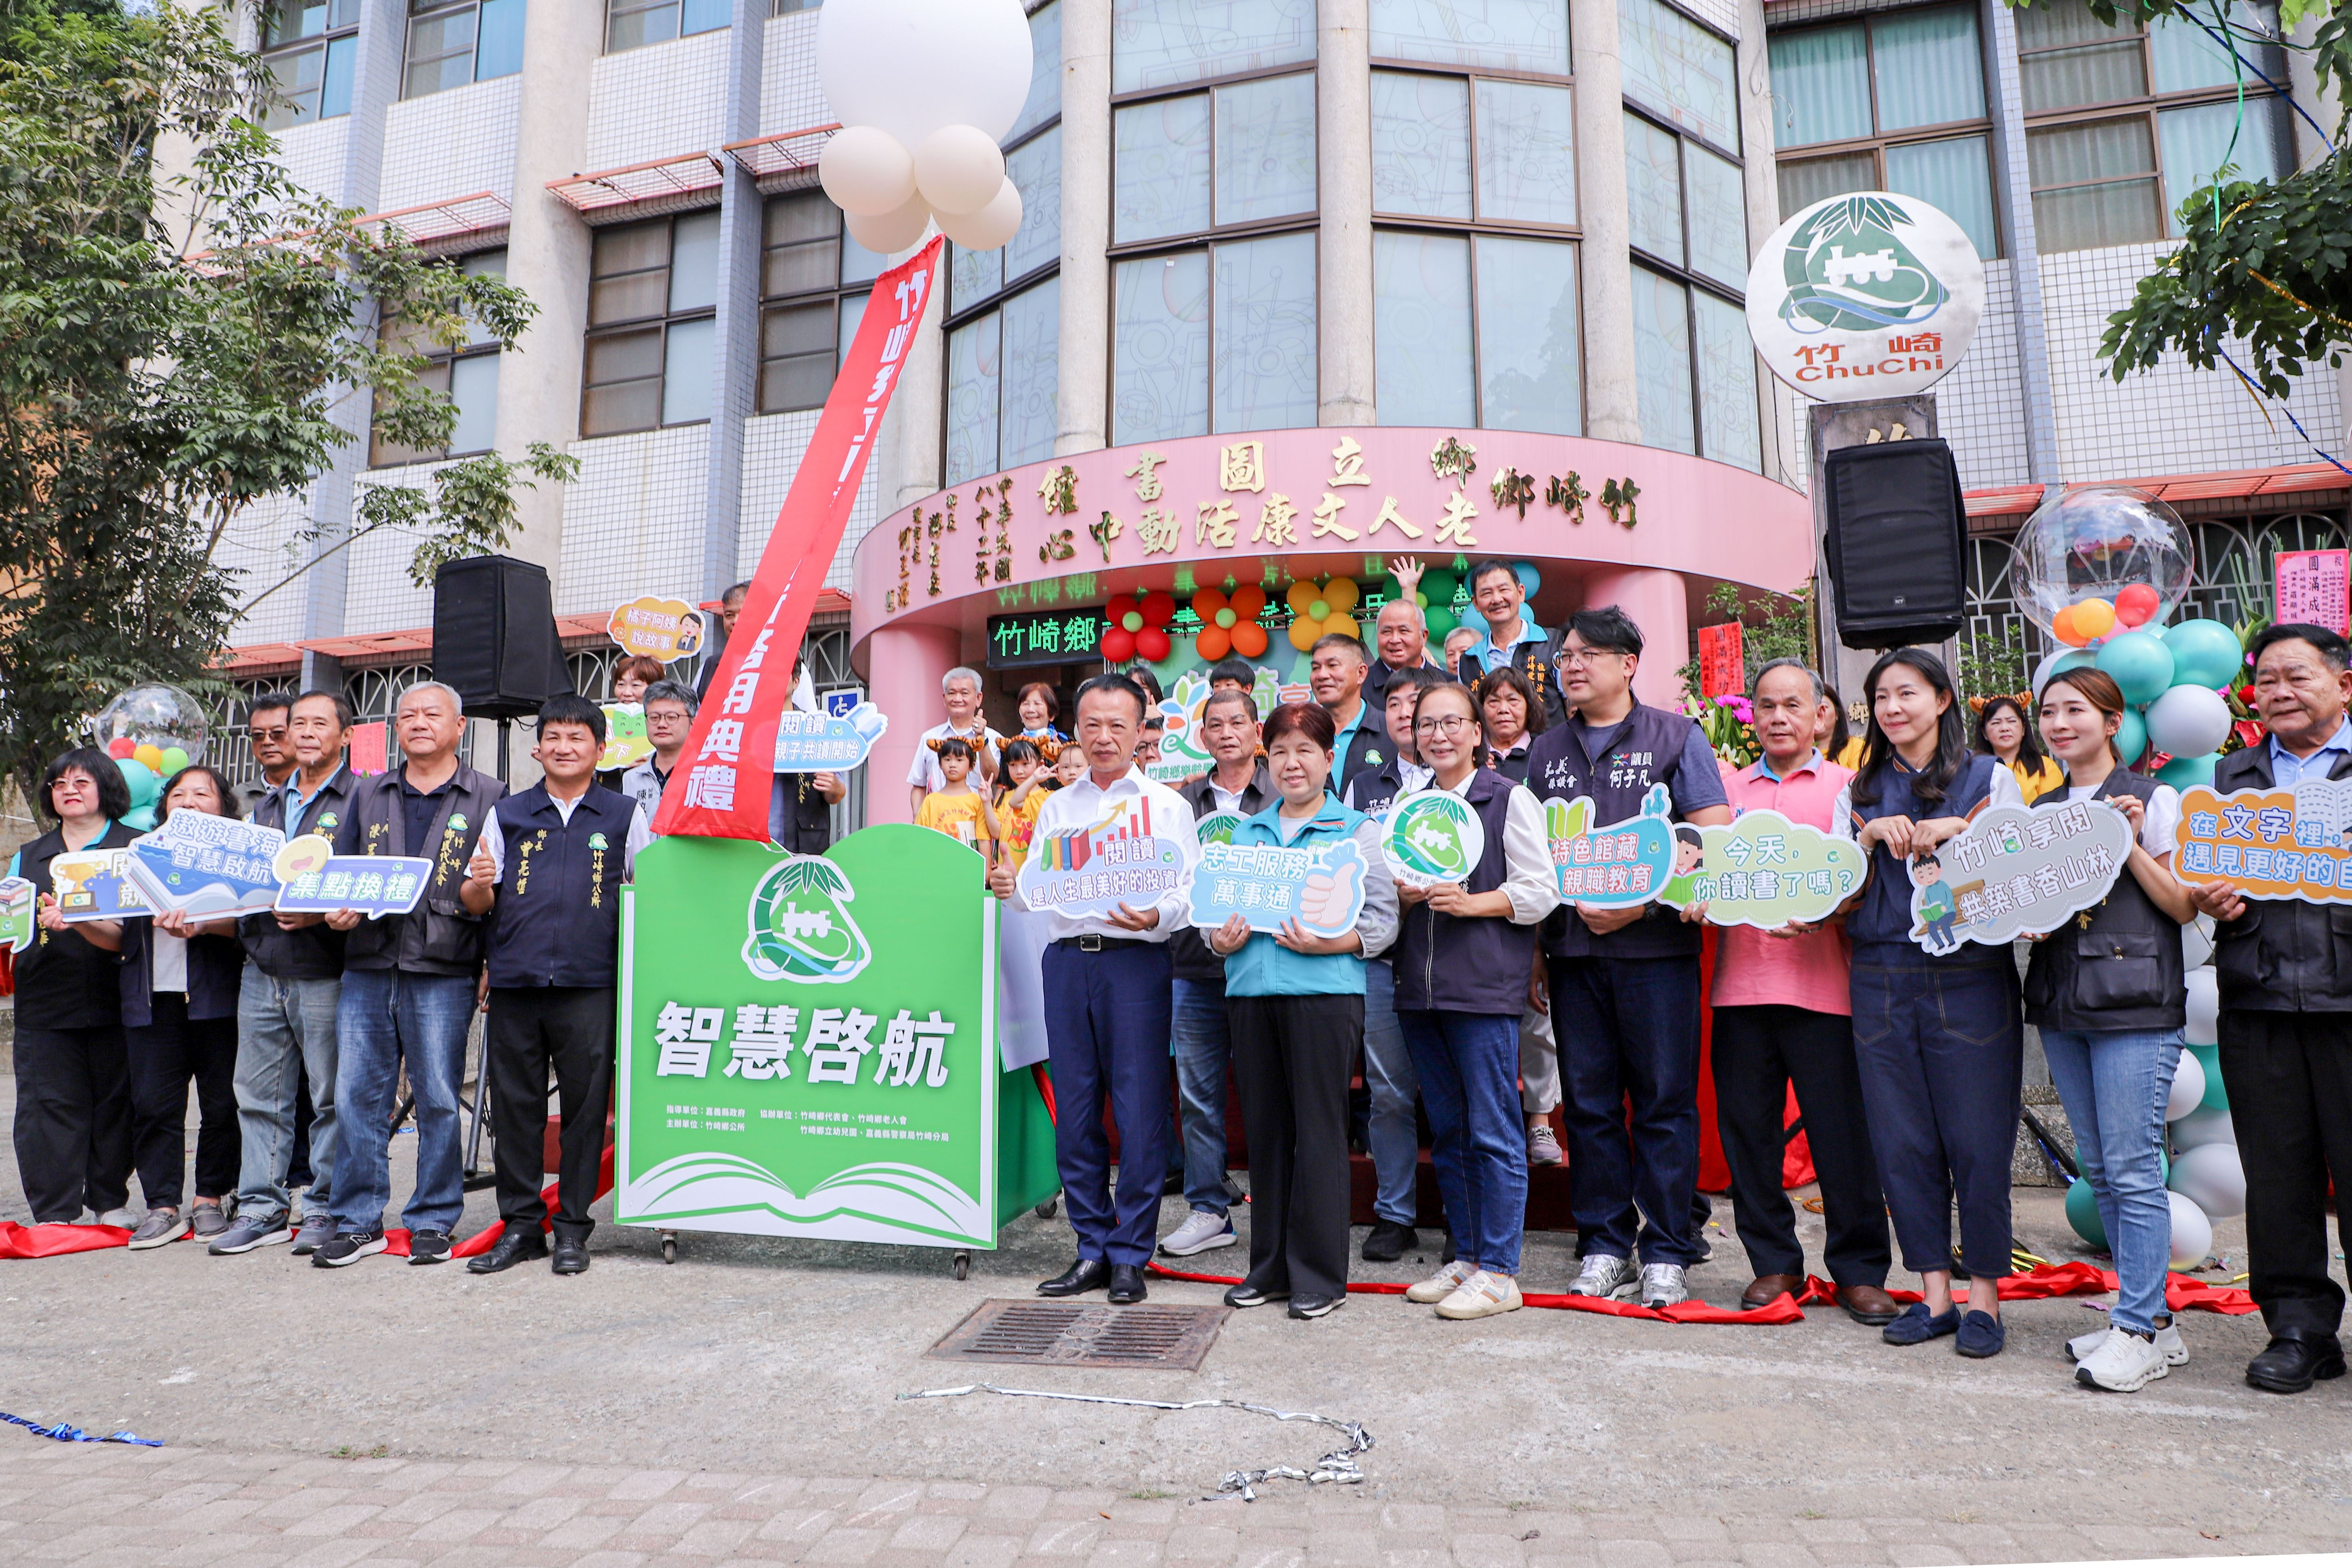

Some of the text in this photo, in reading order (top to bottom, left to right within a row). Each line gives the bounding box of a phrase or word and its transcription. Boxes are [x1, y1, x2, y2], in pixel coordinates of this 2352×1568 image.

[1793, 332, 1943, 365] 竹崎
[1795, 355, 1943, 382] ChuChi
[625, 607, 679, 633] 橘子阿姨
[630, 629, 672, 651] 說故事
[994, 616, 1095, 656] 竹崎鄉
[779, 714, 827, 735] 閱讀
[775, 740, 860, 761] 親子共讀開始
[1609, 768, 1651, 789] 何子凡
[169, 813, 279, 860] 遨遊書海
[1103, 837, 1156, 866] 閱讀
[1551, 833, 1639, 865] 特色館藏
[1952, 802, 2093, 874] 竹崎享閱
[1201, 846, 1309, 880] 志工服務
[288, 872, 418, 902] 集點換禮
[1031, 869, 1178, 908] 是人生最美好的投資
[1212, 878, 1293, 912] 萬事通
[1563, 864, 1652, 895] 親職教育
[1693, 870, 1854, 903] 你讀書了嗎？
[1960, 843, 2115, 927] 共築書香山林
[666, 1105, 745, 1118] 指導單位：嘉義縣政府
[666, 1119, 745, 1132] 主辦單位：竹崎鄉公所
